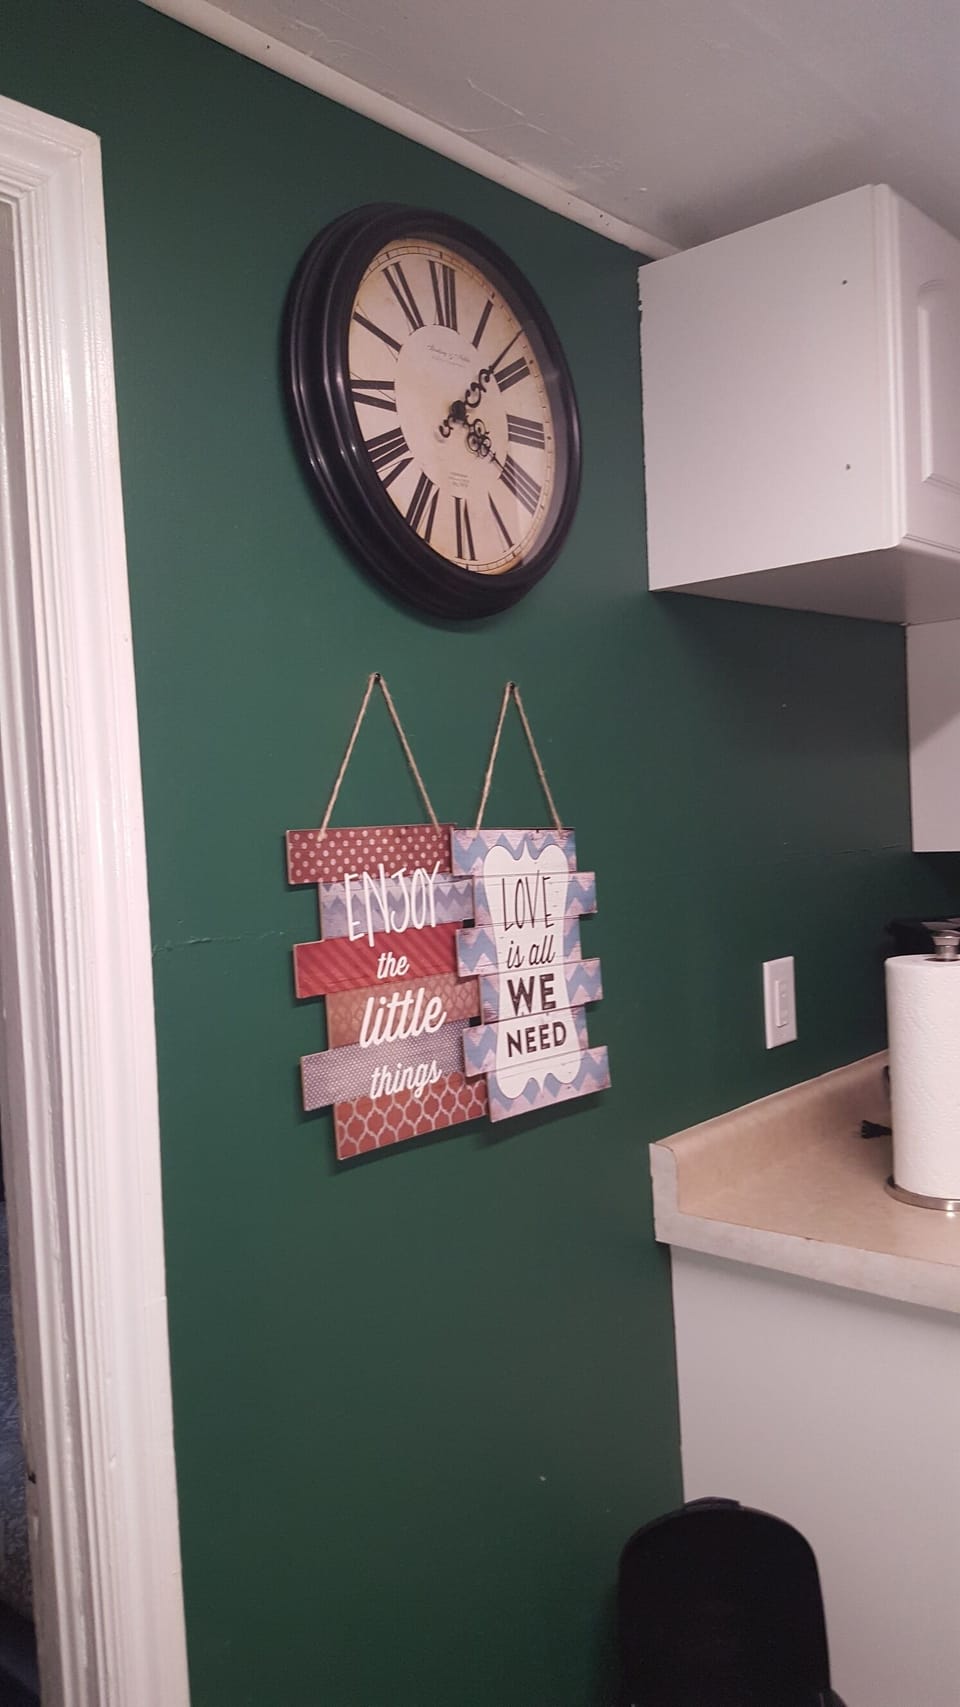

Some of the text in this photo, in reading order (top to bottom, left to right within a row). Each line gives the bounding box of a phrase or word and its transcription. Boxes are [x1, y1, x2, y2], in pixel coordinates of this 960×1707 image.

[344, 861, 441, 948] ENJOY
[501, 869, 555, 932] LOVE
[376, 951, 410, 980] the
[506, 934, 556, 969] is all
[507, 972, 557, 1017] WE
[359, 987, 448, 1049] little
[506, 1021, 567, 1058] NEED
[369, 1059, 443, 1100] things
